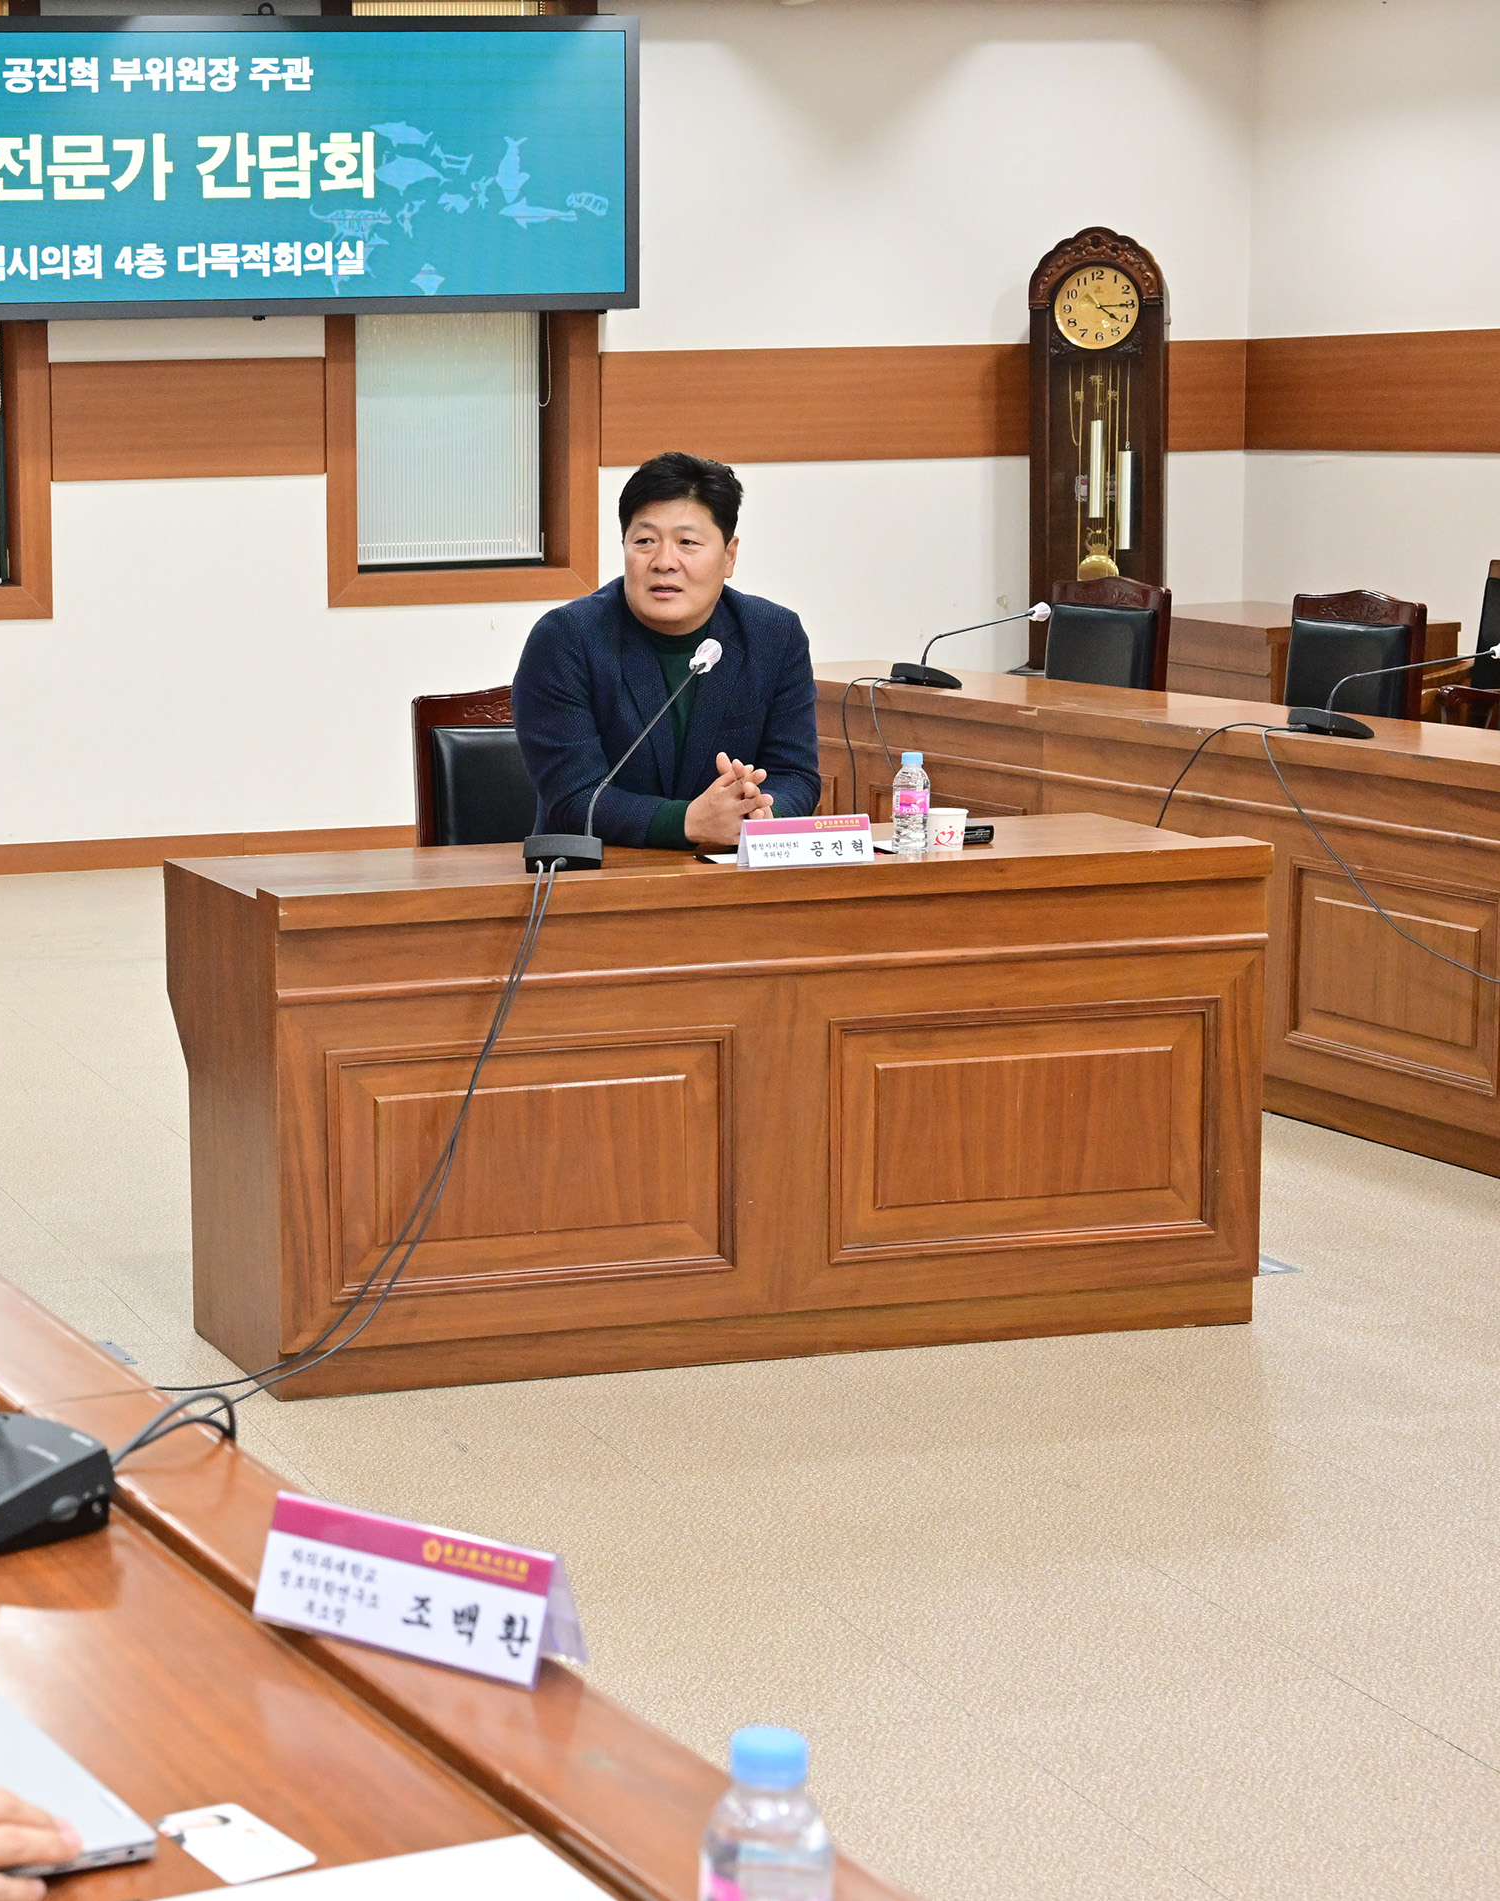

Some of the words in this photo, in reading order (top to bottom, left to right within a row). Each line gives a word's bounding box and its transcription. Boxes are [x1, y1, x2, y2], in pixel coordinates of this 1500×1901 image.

[2, 57, 99, 93] 공진혁
[110, 56, 240, 92] 부위원장
[249, 56, 314, 92] 주관
[196, 131, 376, 200] 간담회
[114, 243, 167, 279] 4층
[177, 240, 365, 278] 다목적회의실
[1091, 270, 1104, 280] 12
[1077, 277, 1087, 287] 11
[1067, 289, 1078, 299] 10
[1122, 285, 1131, 294] 2
[1064, 304, 1073, 314] 9
[1126, 300, 1135, 309] 3
[1067, 318, 1077, 327] 8
[1121, 315, 1129, 323] 4
[1079, 329, 1088, 338] 7
[1095, 332, 1104, 341] 6
[1111, 327, 1121, 336] 5
[810, 839, 864, 857] 공진혁
[402, 1596, 531, 1659] 조백환
